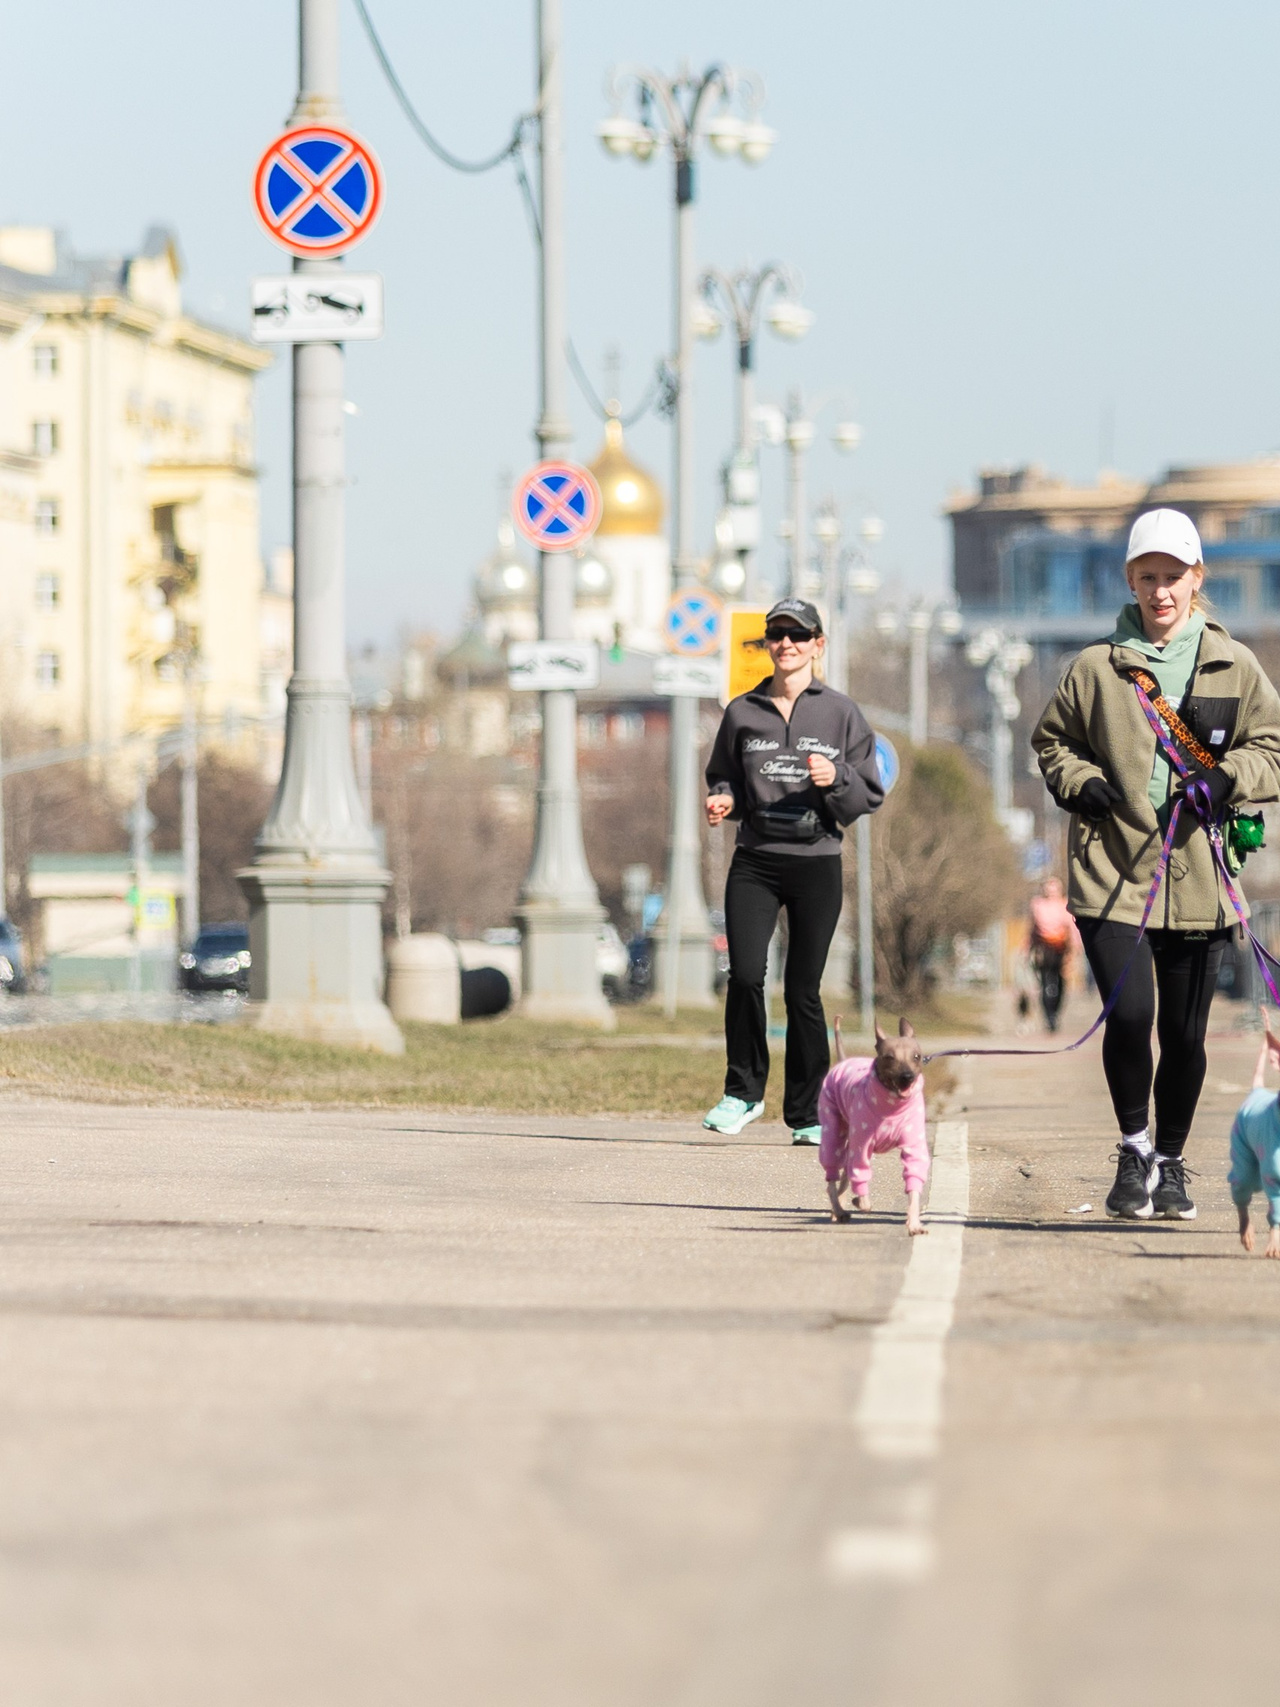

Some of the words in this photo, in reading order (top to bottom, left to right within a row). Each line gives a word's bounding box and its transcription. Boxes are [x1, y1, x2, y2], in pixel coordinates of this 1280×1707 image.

[743, 739, 780, 752] Athletic
[796, 736, 840, 760] Training
[759, 761, 811, 780] Academy
